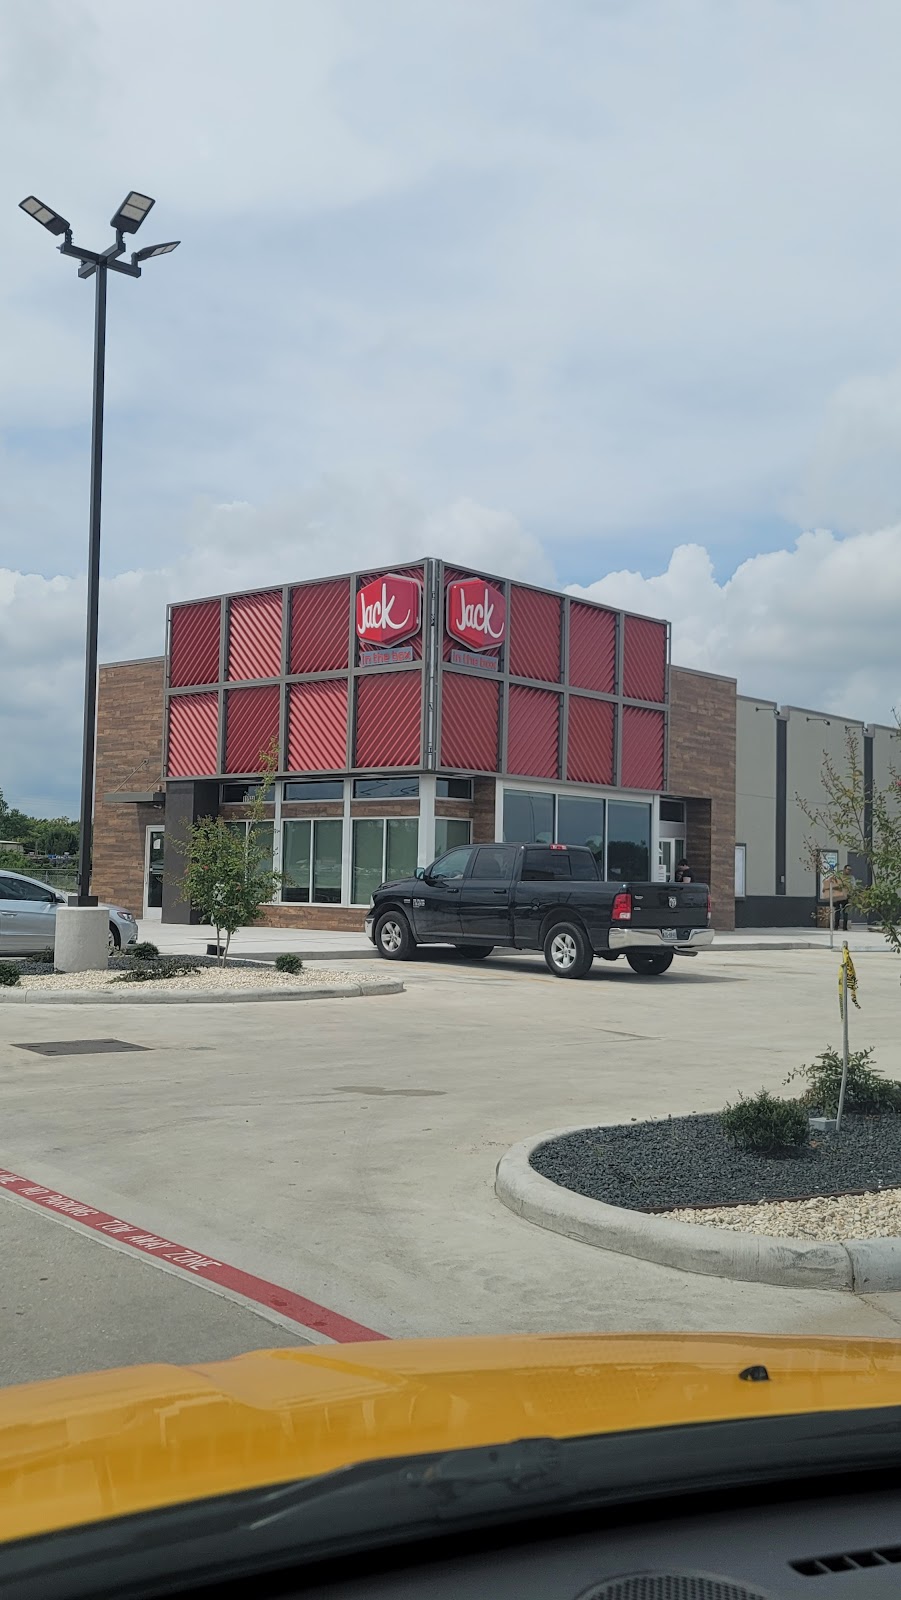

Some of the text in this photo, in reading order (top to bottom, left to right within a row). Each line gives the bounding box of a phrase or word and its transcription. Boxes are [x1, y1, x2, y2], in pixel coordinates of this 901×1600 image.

[358, 583, 410, 634] Jack
[456, 588, 504, 638] Jack
[362, 650, 411, 665] in the box
[453, 652, 496, 669] in the box
[19, 1186, 49, 1195] NO
[36, 1195, 99, 1217] PARKING
[96, 1219, 137, 1234] TOW
[124, 1234, 176, 1250] AWAY
[163, 1250, 222, 1270] ZONE
